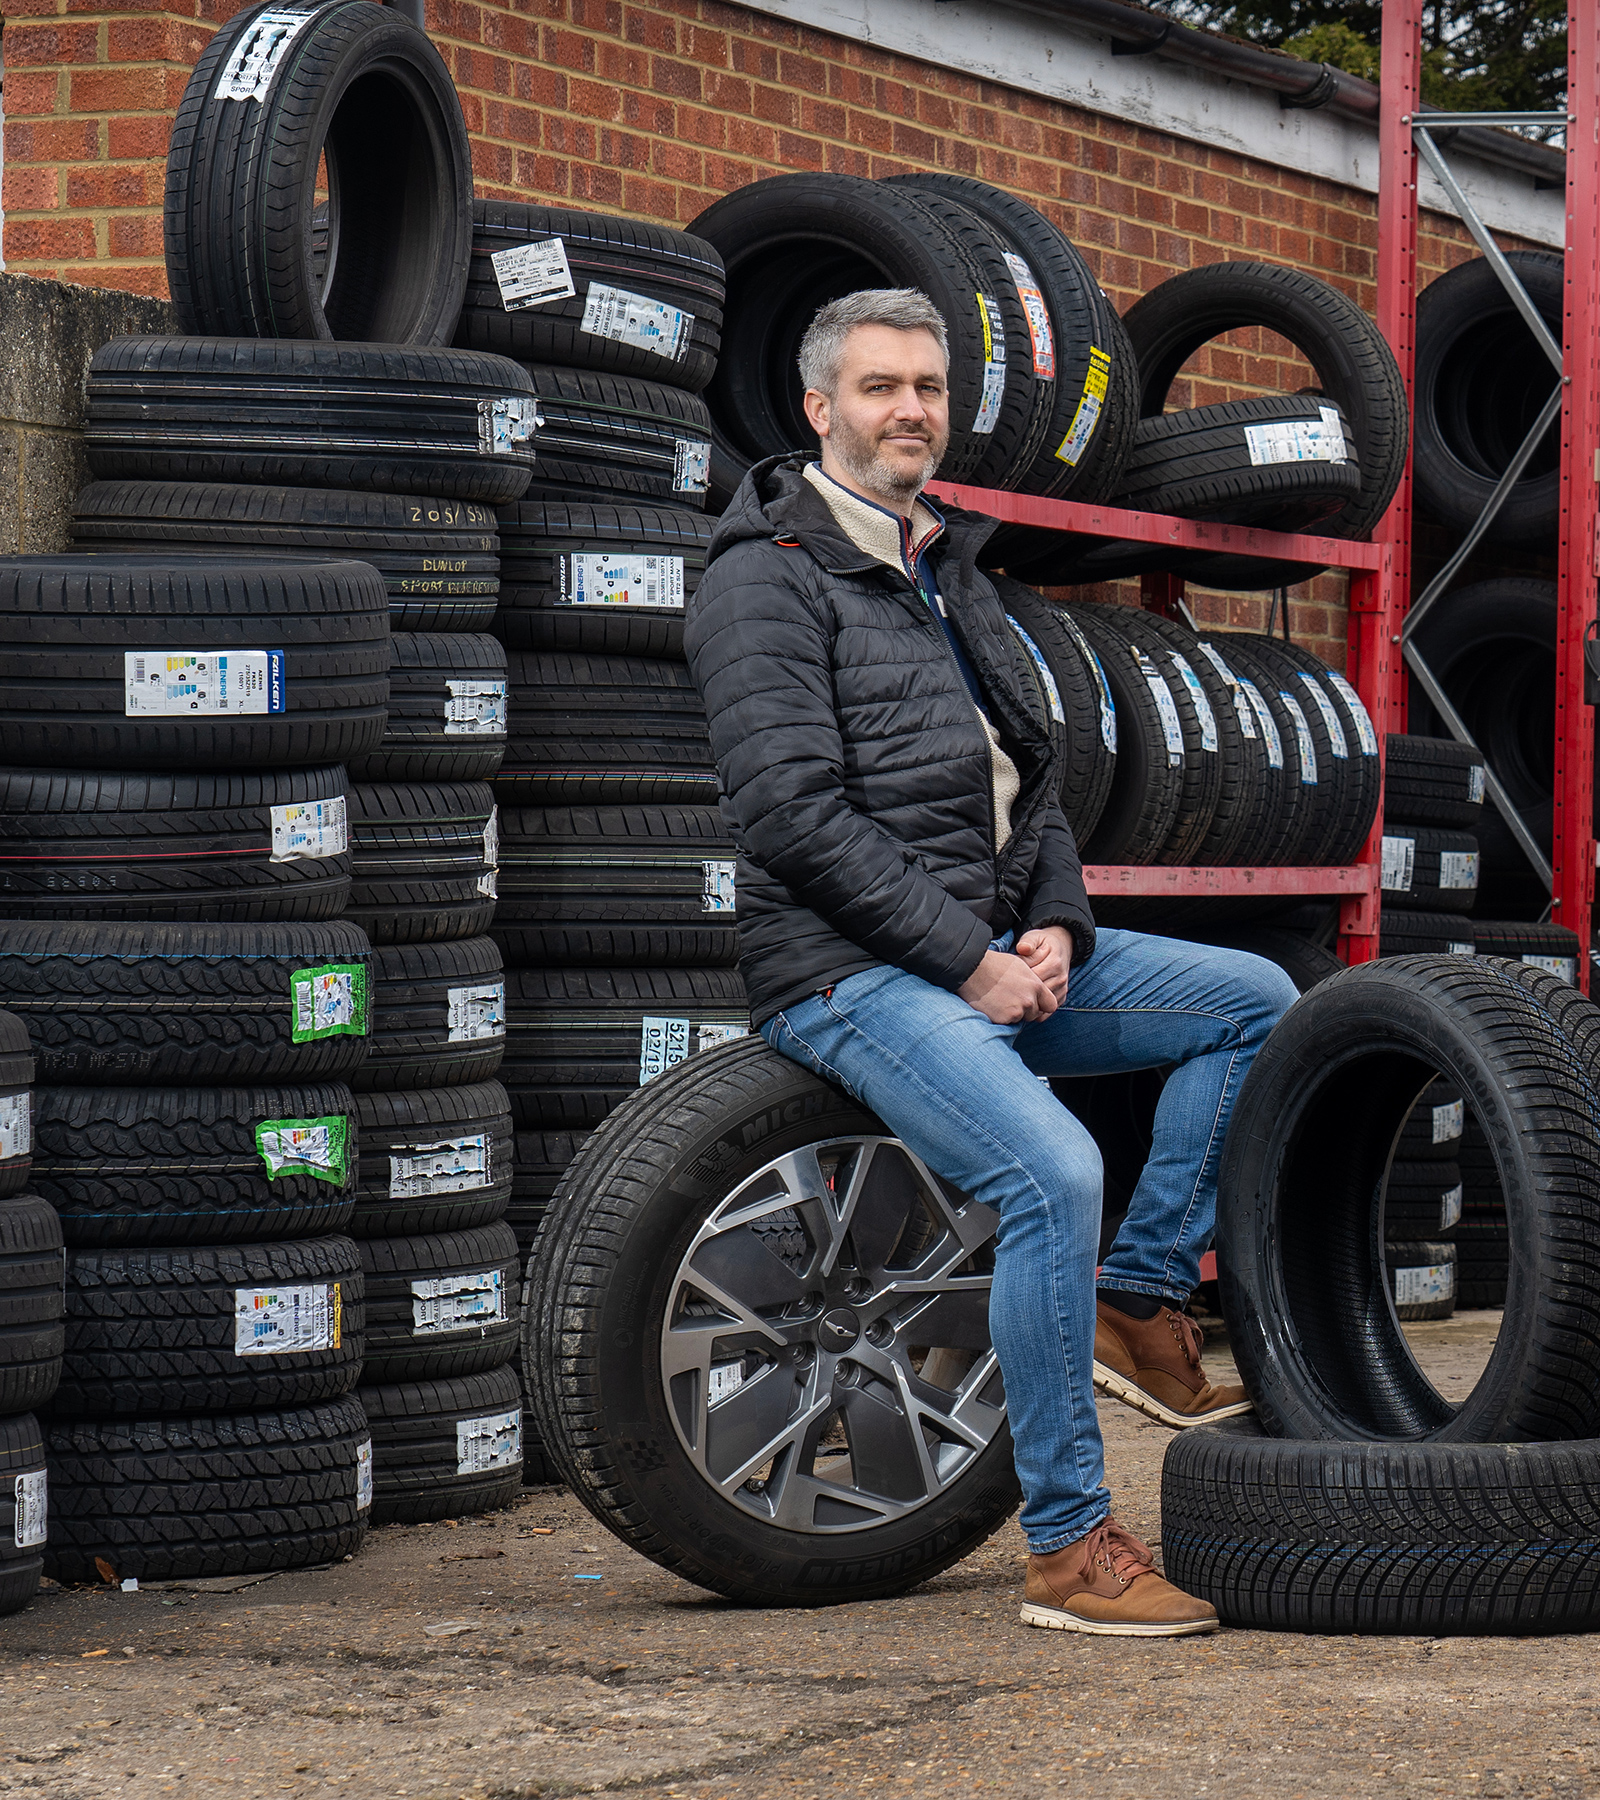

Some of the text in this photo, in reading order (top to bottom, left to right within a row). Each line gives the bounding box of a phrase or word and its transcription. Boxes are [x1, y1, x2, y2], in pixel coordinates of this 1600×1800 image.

[596, 292, 605, 313] SPORT
[423, 559, 468, 572] DUNLOP
[401, 579, 444, 593] SPORT
[669, 596, 676, 605] SP
[271, 654, 280, 710] FALKEN
